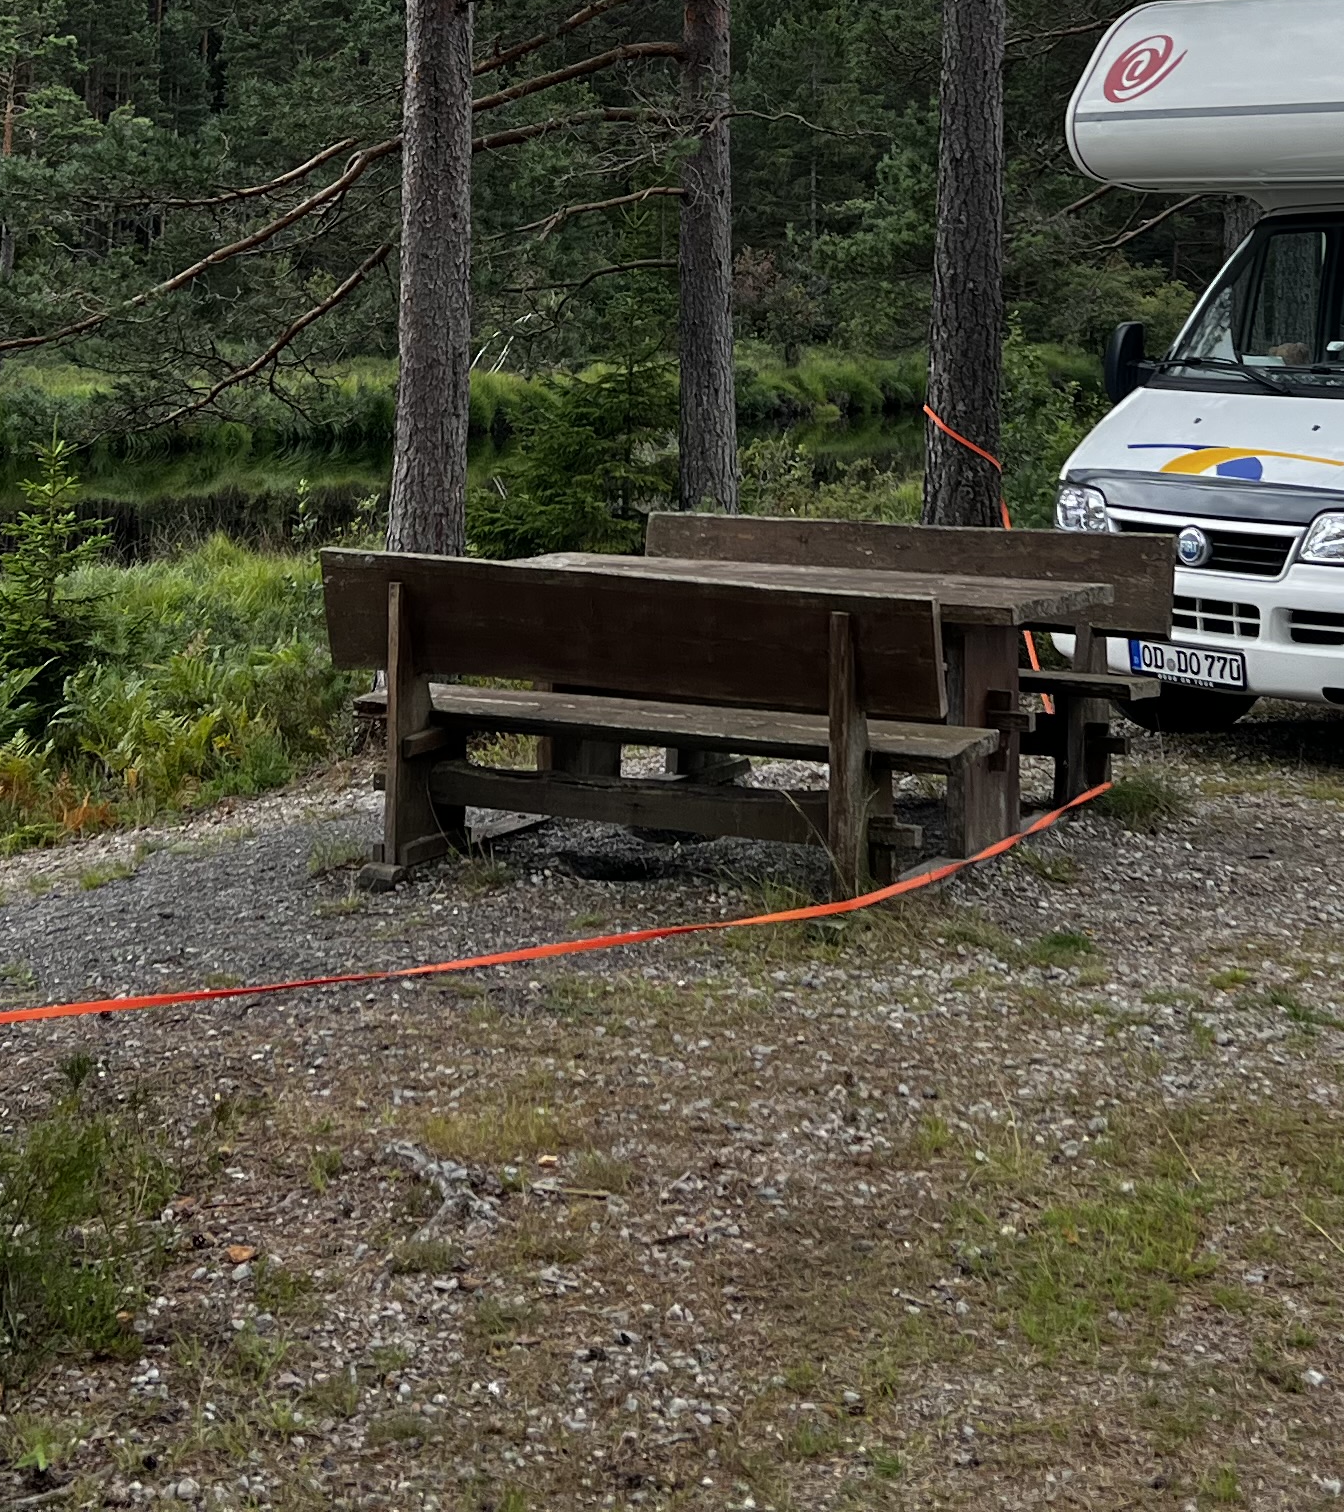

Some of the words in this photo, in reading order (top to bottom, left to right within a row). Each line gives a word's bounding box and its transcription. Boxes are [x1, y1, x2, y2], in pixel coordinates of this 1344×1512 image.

[1142, 644, 1165, 670] OD
[1175, 649, 1201, 676] DO
[1204, 654, 1241, 681] 770
